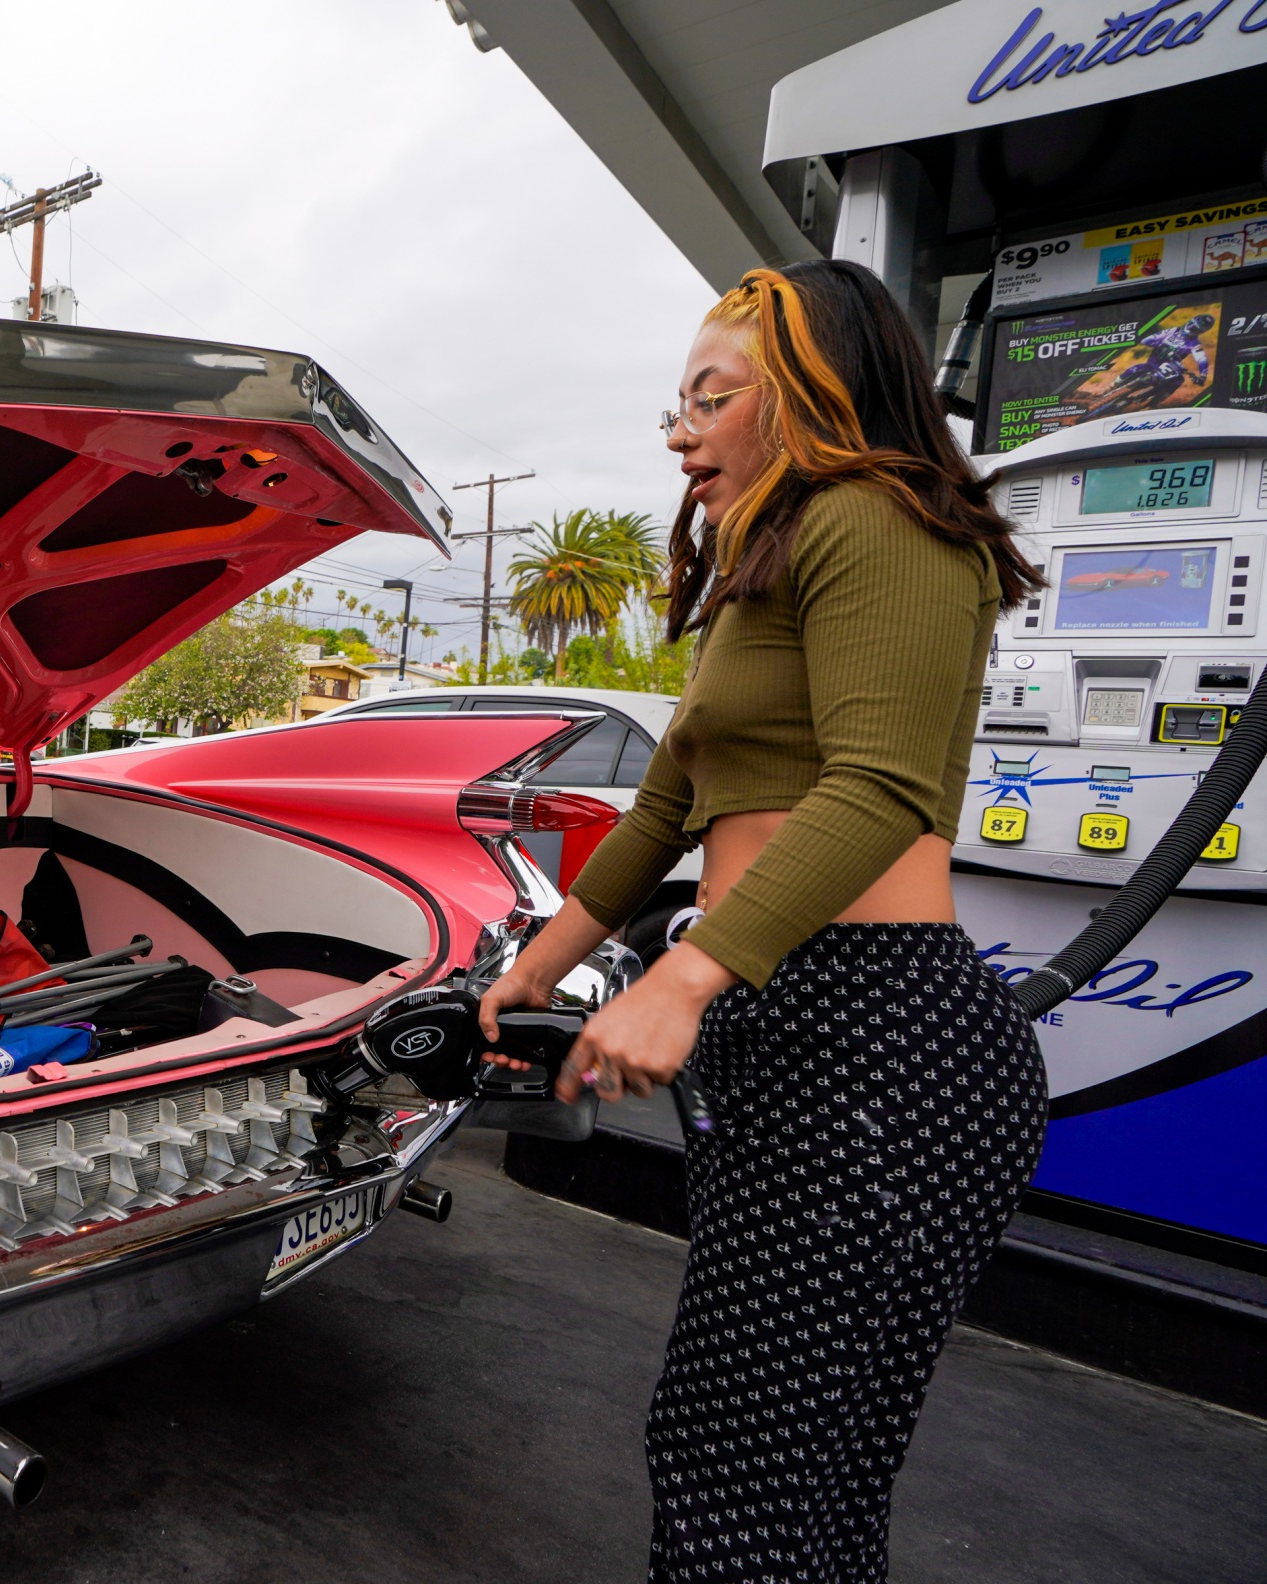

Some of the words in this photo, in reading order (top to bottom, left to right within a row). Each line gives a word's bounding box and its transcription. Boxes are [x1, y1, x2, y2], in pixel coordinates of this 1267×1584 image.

[967, 0, 1232, 104] United
[1115, 219, 1171, 240] EASY
[1175, 200, 1267, 228] SAVINGS
[1207, 237, 1242, 249] CAMEL
[997, 281, 1023, 289] WHEN
[1025, 277, 1042, 285] YOU
[1015, 272, 1037, 281] PACK
[1009, 338, 1029, 348] BUY
[1030, 332, 1077, 344] MONSTER
[1078, 325, 1118, 337] ENERGY
[1119, 322, 1139, 332] GET
[1007, 346, 1035, 362] $15
[1038, 339, 1081, 359] OFF
[1083, 331, 1136, 347] TICKETS
[1034, 396, 1060, 404] ENTER
[1001, 410, 1032, 423] BUY
[1000, 423, 1040, 437] SNAP
[1111, 421, 1159, 434] United
[1160, 417, 1192, 430] Oil
[1071, 475, 1080, 485] $
[1149, 466, 1210, 490] 9.68
[1137, 491, 1189, 507] 1.826
[990, 778, 1031, 787] Unleaded
[1089, 784, 1133, 793] Unleaded
[1099, 793, 1120, 801] Plus
[990, 819, 1017, 832] 87
[1089, 826, 1118, 841] 89
[1214, 836, 1226, 850] 1
[1076, 860, 1132, 872] GILBARCO
[398, 1031, 432, 1054] VST
[278, 1232, 340, 1267] dmv.ca.gov
